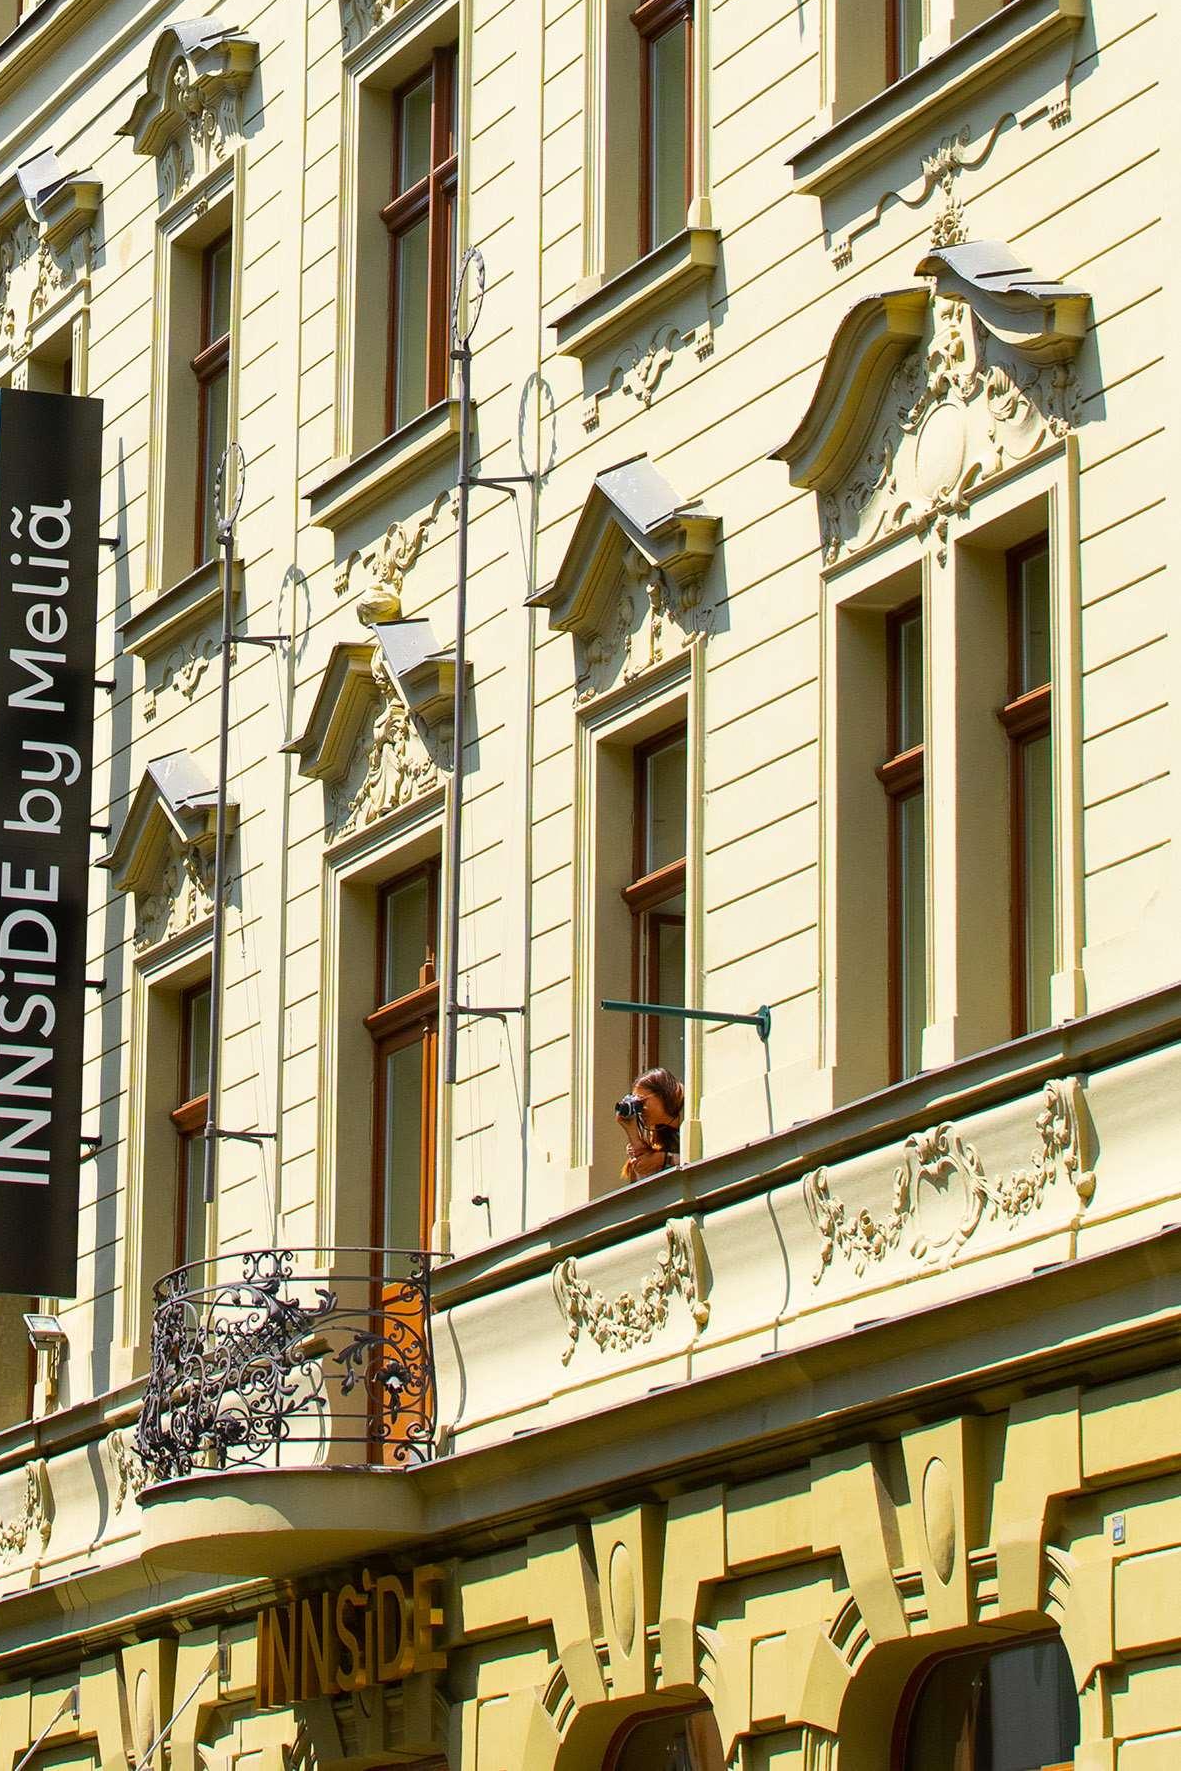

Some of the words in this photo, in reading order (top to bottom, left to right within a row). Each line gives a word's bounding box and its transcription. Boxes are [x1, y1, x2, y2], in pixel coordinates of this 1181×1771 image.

[7, 499, 72, 712] Meliã
[3, 740, 82, 834] by
[256, 1566, 447, 1709] INNSiDE
